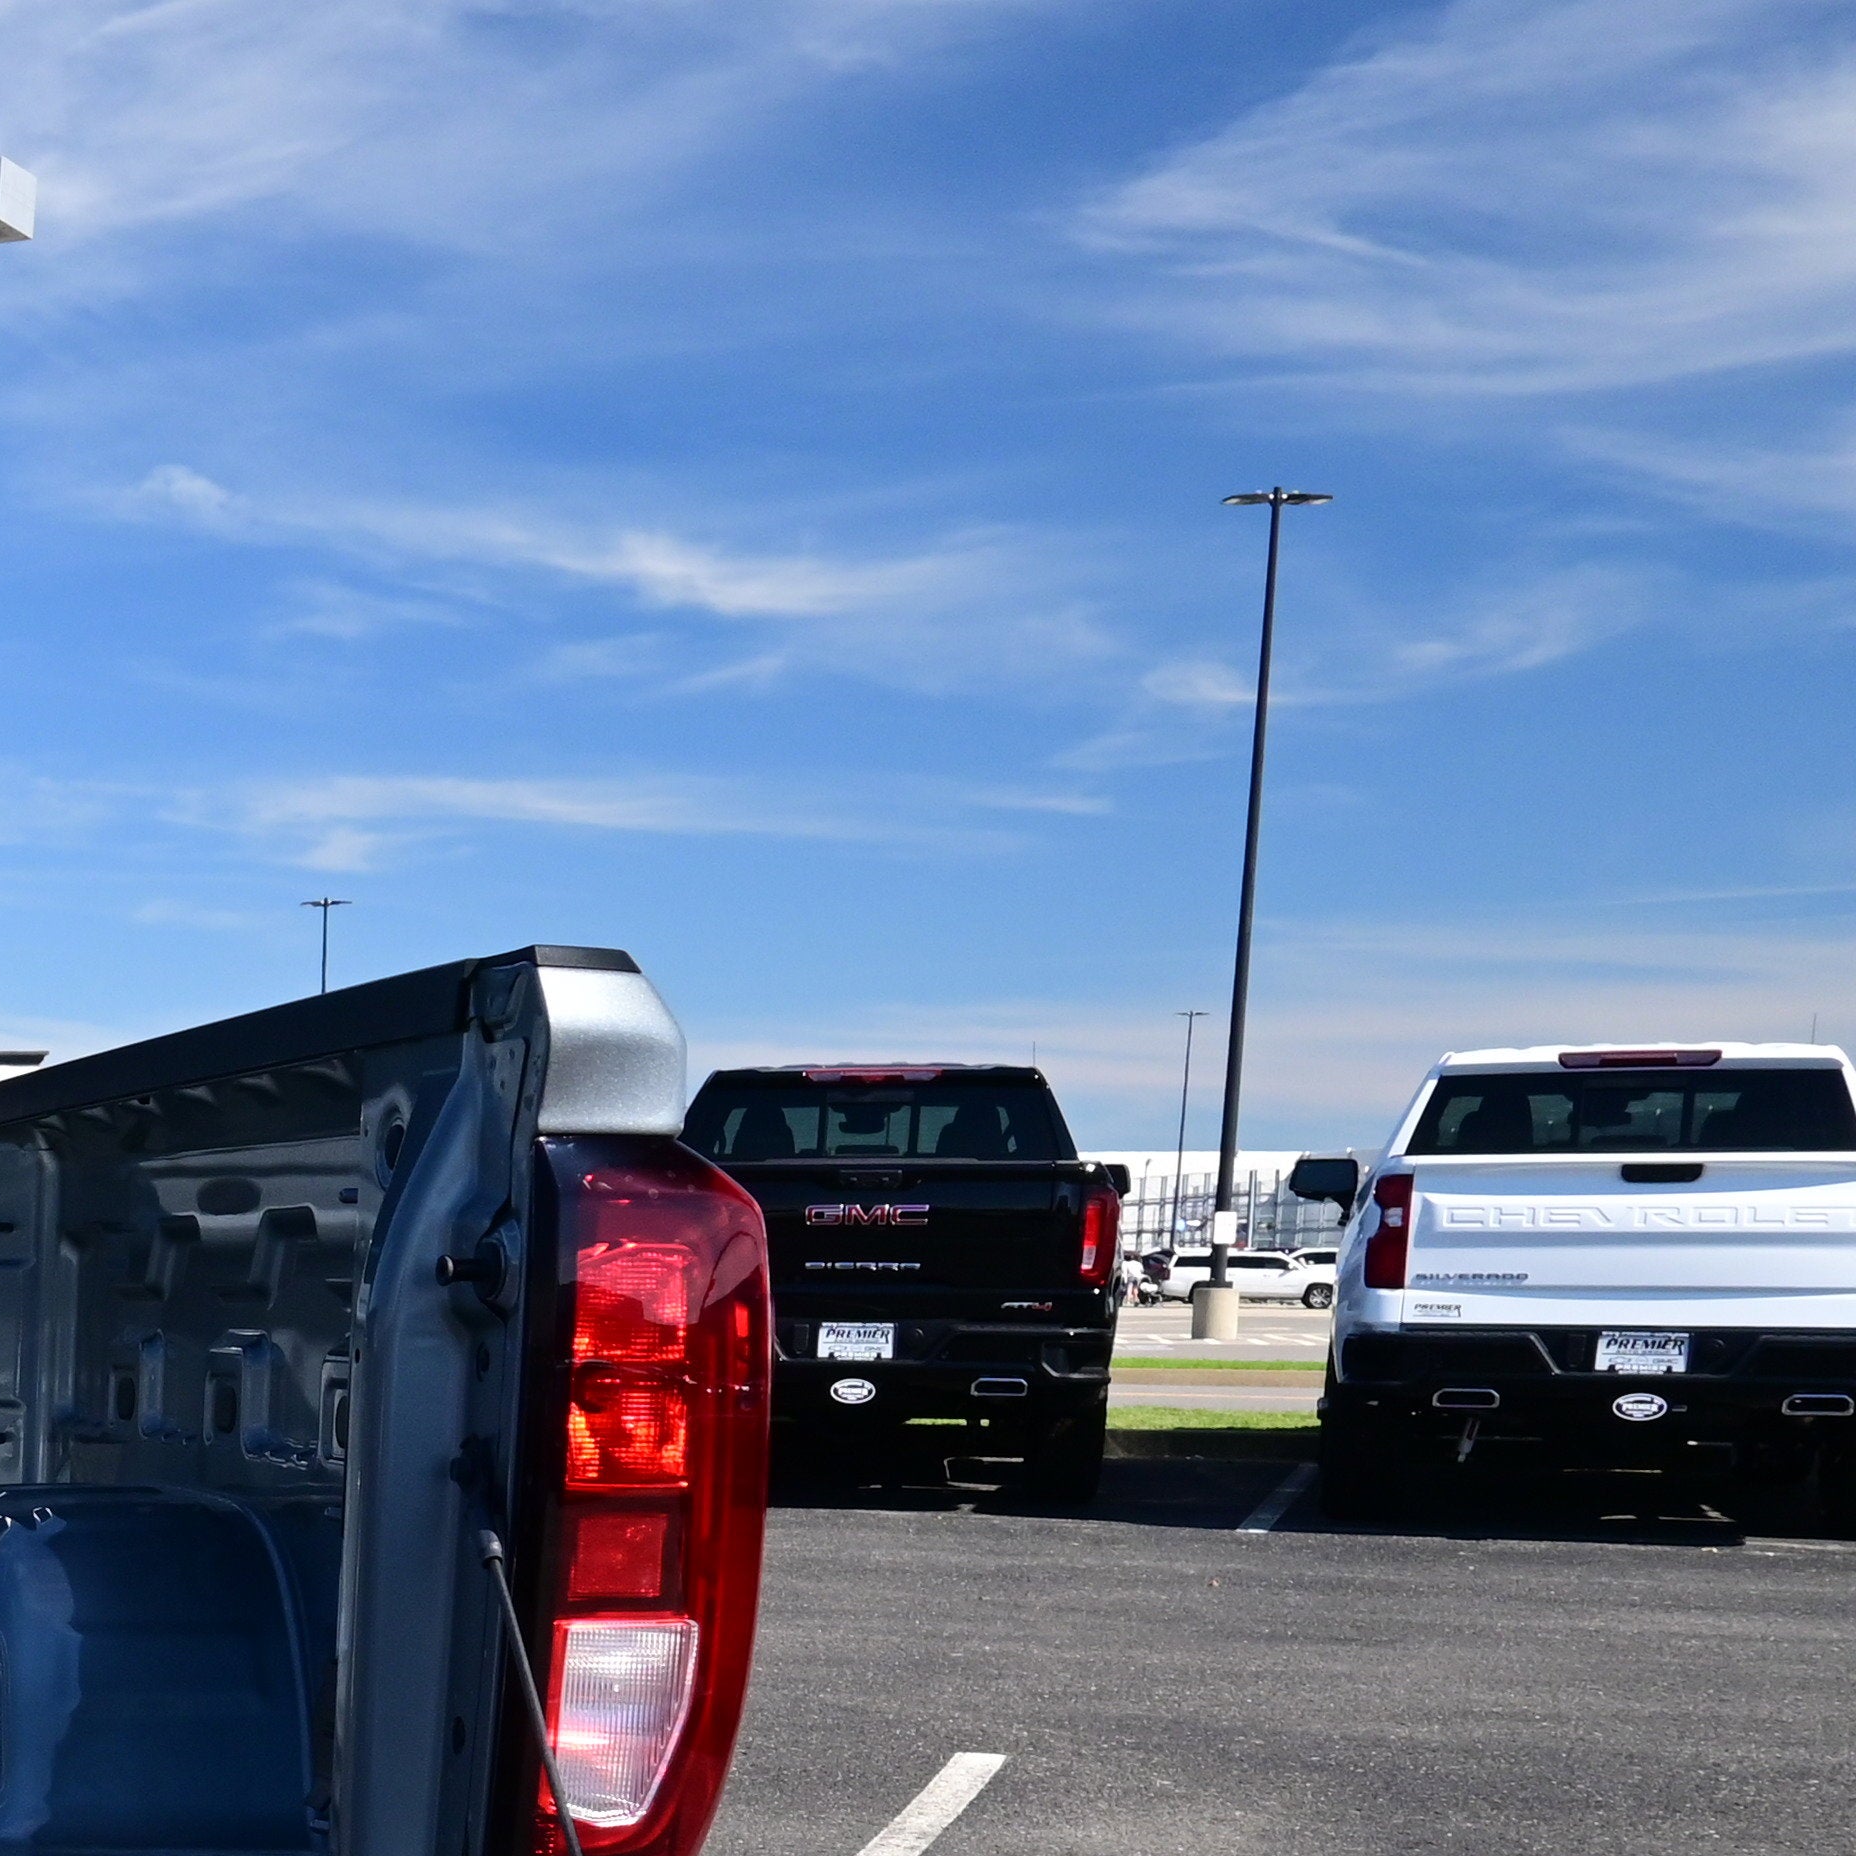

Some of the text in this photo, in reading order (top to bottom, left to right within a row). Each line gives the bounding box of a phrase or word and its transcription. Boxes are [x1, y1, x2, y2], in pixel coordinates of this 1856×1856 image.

[805, 1203, 930, 1226] GMC
[1415, 1273, 1529, 1281] SILVERADO
[826, 1328, 890, 1344] PREMIER
[1605, 1338, 1684, 1355] PREMIER
